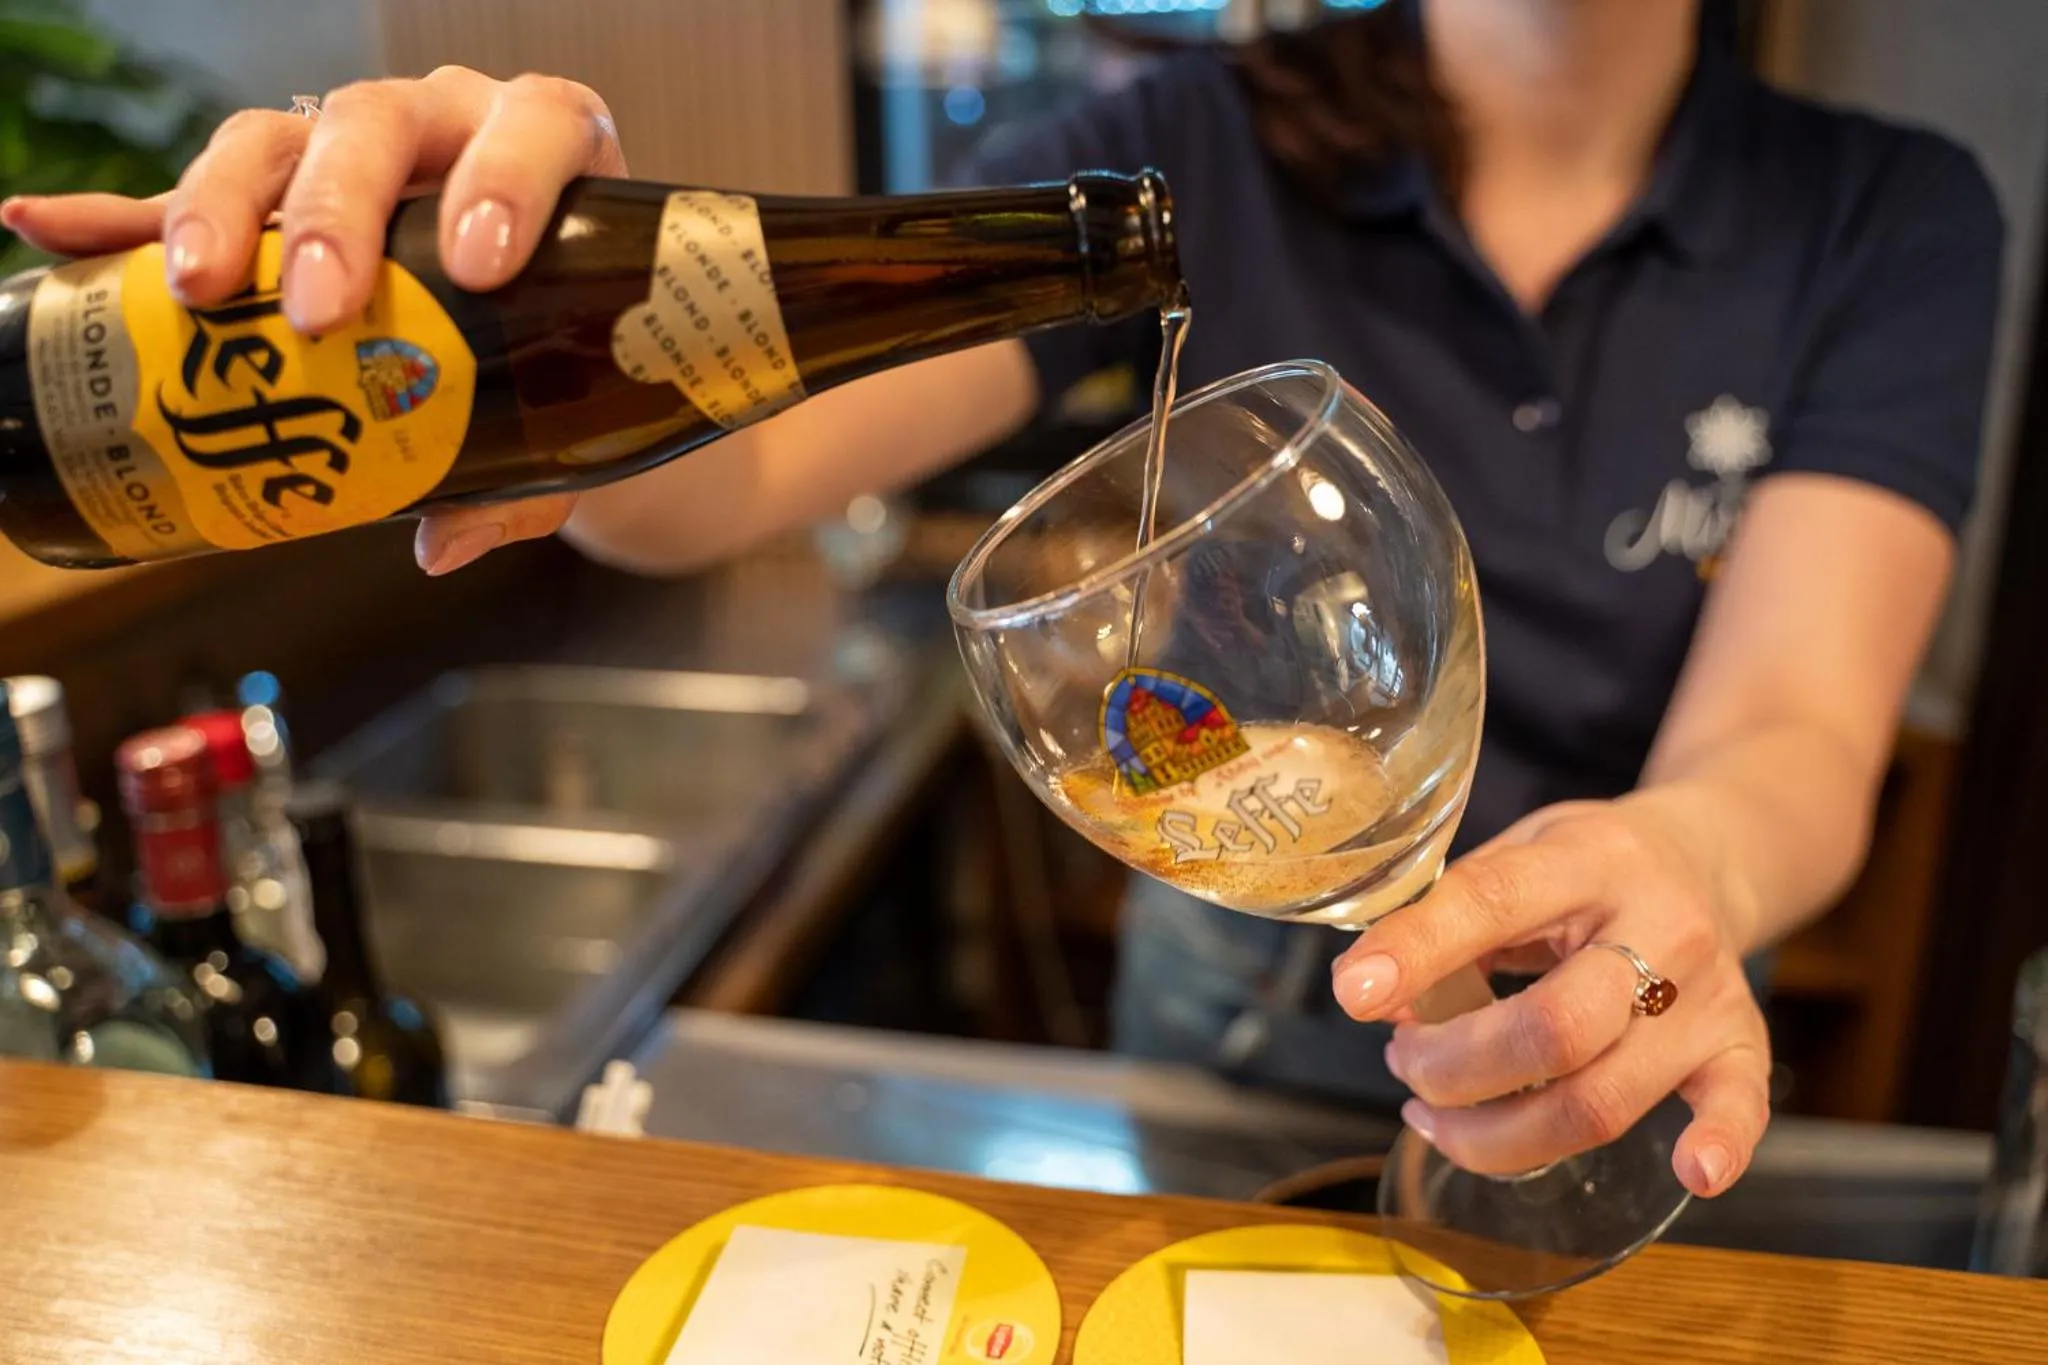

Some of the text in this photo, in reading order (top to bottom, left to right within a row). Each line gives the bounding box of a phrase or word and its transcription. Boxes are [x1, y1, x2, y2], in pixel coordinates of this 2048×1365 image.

[643, 313, 704, 389] BLONDE
[656, 265, 768, 406] BLOND BLONDE
[667, 222, 787, 371] BLONDE BLOND
[82, 290, 119, 423] BLONDE
[105, 439, 177, 537] BLOND
[1156, 772, 1333, 864] Leffe
